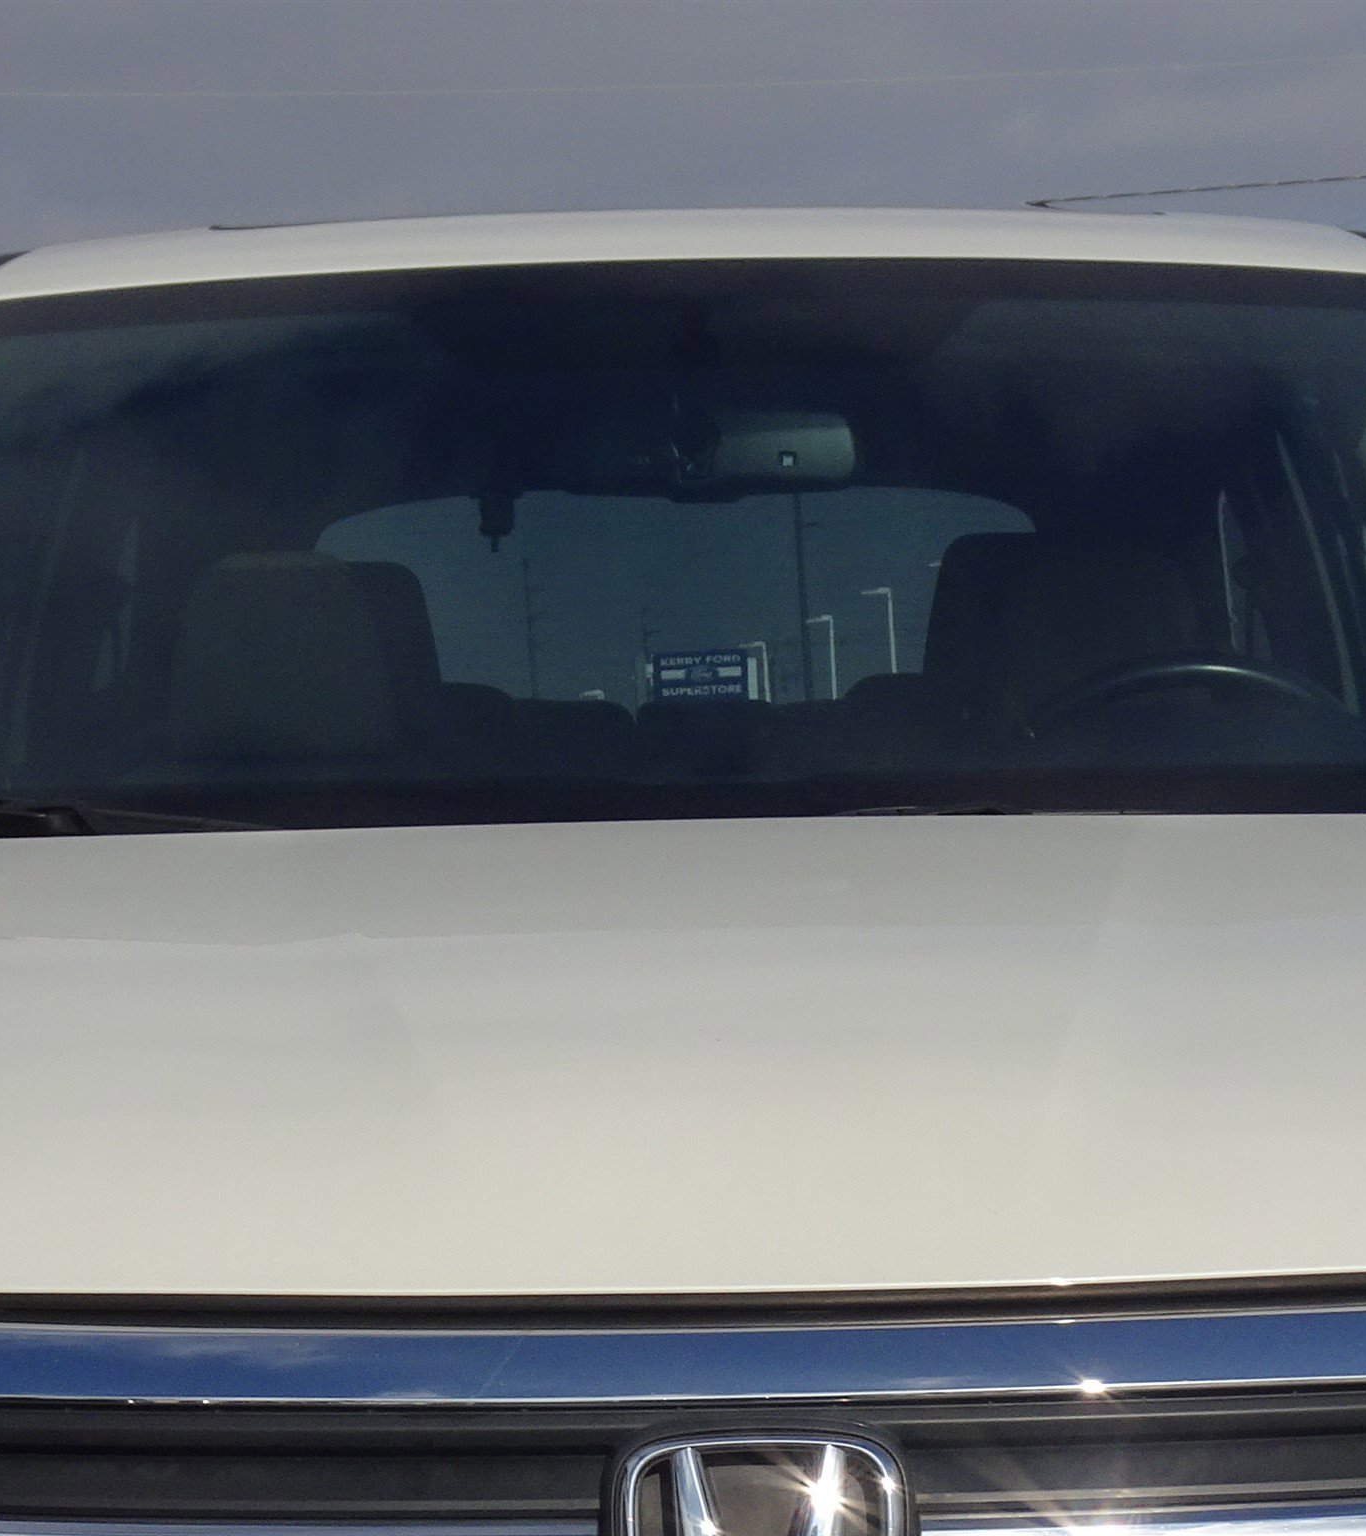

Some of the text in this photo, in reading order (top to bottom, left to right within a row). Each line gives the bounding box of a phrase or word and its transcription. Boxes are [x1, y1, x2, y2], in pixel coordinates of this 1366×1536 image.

[660, 654, 741, 667] KERRY FORD
[662, 684, 742, 697] SUPERSTORE
